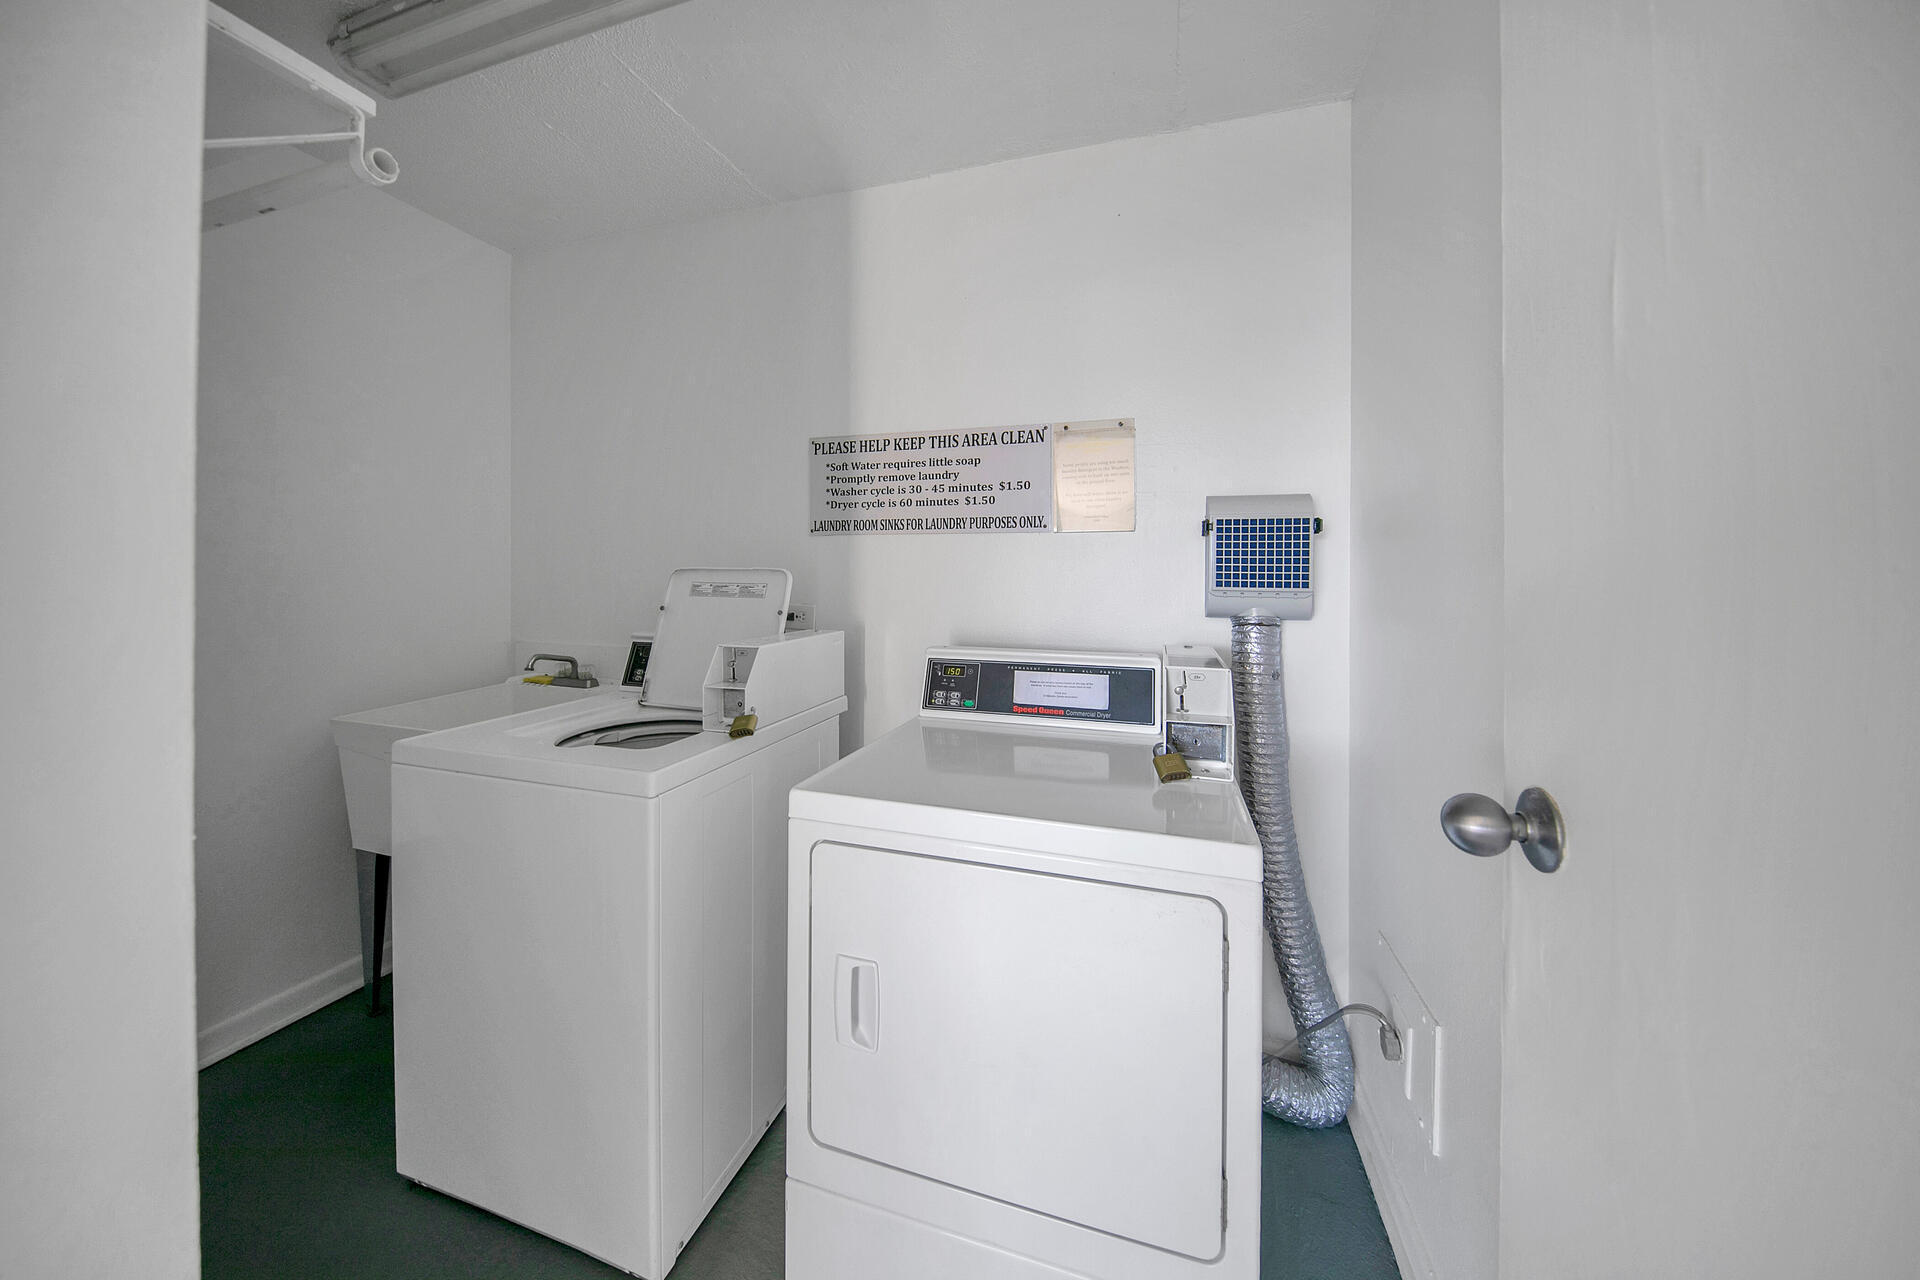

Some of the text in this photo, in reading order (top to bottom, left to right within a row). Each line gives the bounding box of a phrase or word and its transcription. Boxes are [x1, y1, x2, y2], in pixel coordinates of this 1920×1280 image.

[814, 429, 1045, 455] PLEASE HELP KEEP THIS AREA CLEAN
[851, 461, 880, 470] Water
[883, 459, 926, 471] requires
[929, 457, 953, 466] little
[956, 457, 981, 467] soap
[878, 473, 916, 482] remove
[918, 470, 959, 481] laundry
[870, 486, 894, 497] cycle
[897, 485, 906, 494] is
[909, 485, 922, 494] 30
[931, 484, 944, 493] 45
[948, 483, 993, 492] minutes
[999, 480, 1031, 491] $1.50
[861, 499, 885, 510] cycle
[888, 499, 896, 507] is
[900, 498, 912, 507] 60
[916, 497, 959, 507] minutes
[964, 495, 996, 505] $1.50
[814, 520, 851, 532] LAUNDRY
[853, 519, 878, 531] ROOM
[880, 518, 905, 530] SINKS
[906, 518, 924, 530] FOR
[926, 517, 967, 530] LAUNDRY
[969, 516, 1017, 529] PURPOSES
[1012, 705, 1112, 719] Speed Queen Commercial Dryer
